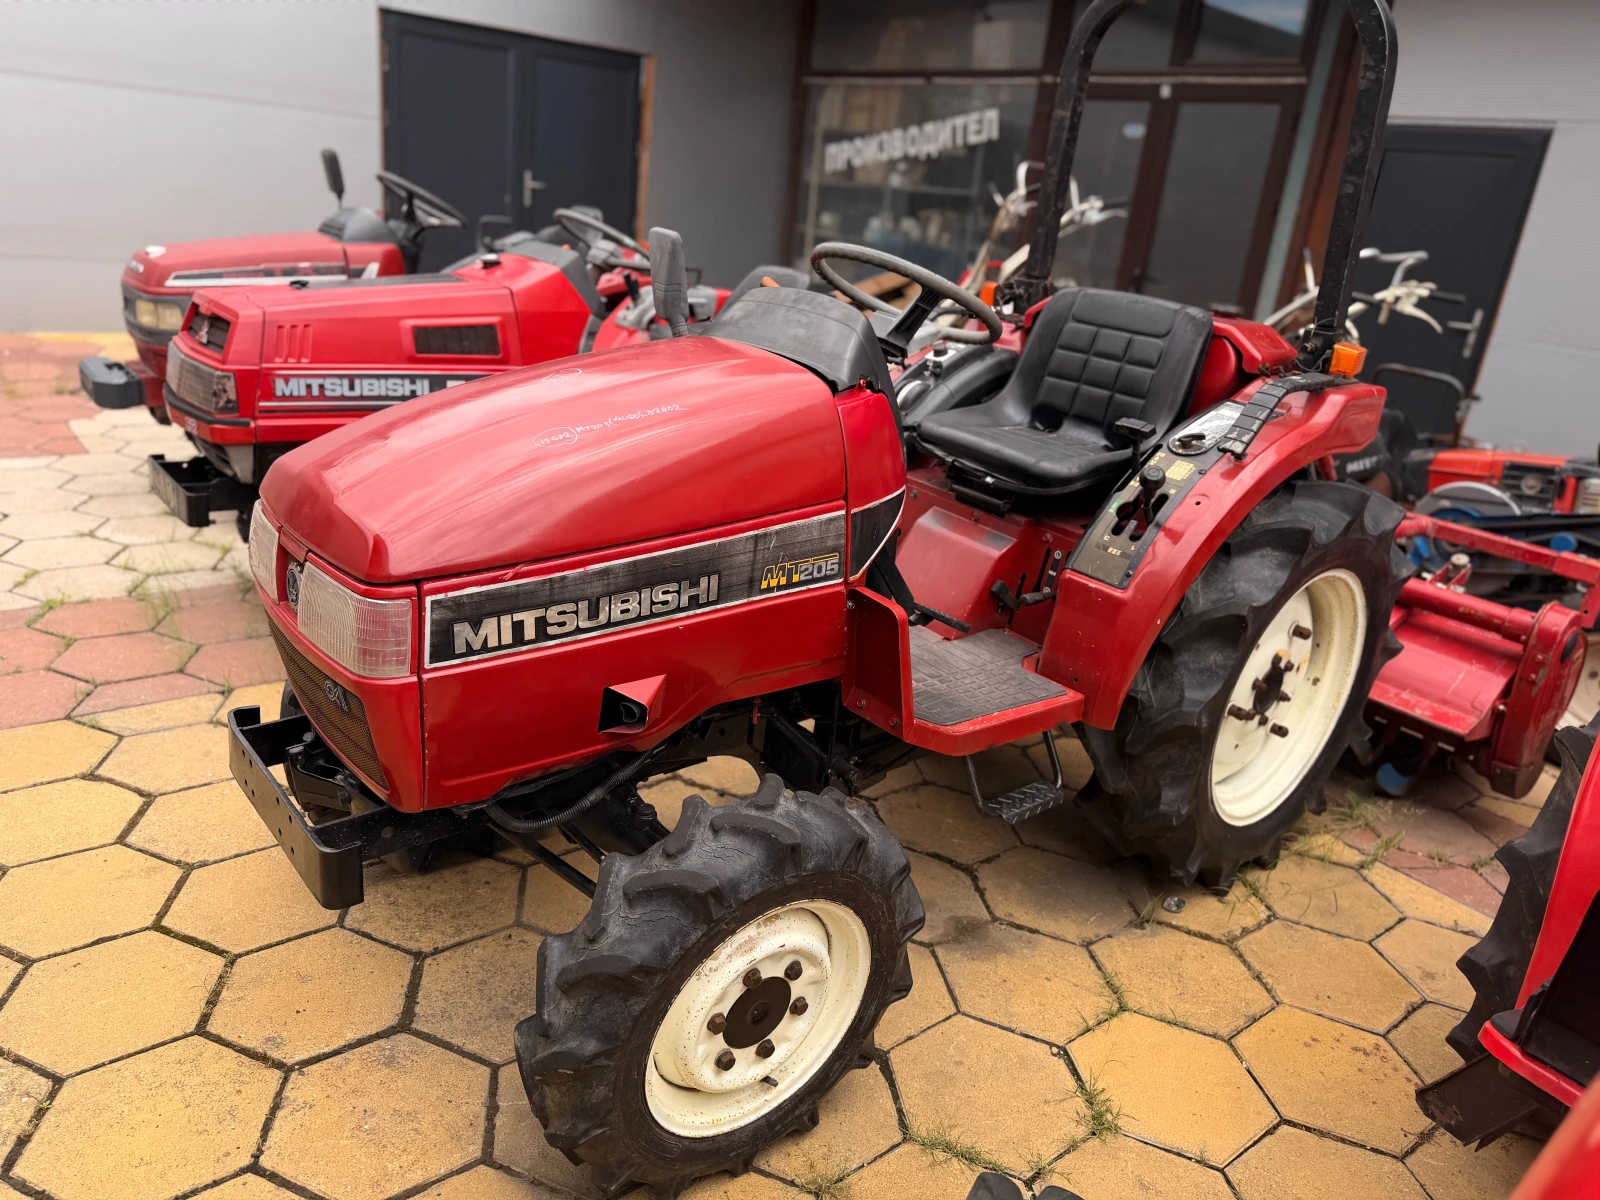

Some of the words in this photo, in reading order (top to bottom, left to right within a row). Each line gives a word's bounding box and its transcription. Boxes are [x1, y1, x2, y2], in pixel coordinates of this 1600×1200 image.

[824, 107, 1001, 174] ПРОИЗВОДИТЕЛ
[273, 377, 430, 398] MITSUBISHI
[452, 574, 720, 655] MITSUBISHI
[760, 553, 839, 590] MT205
